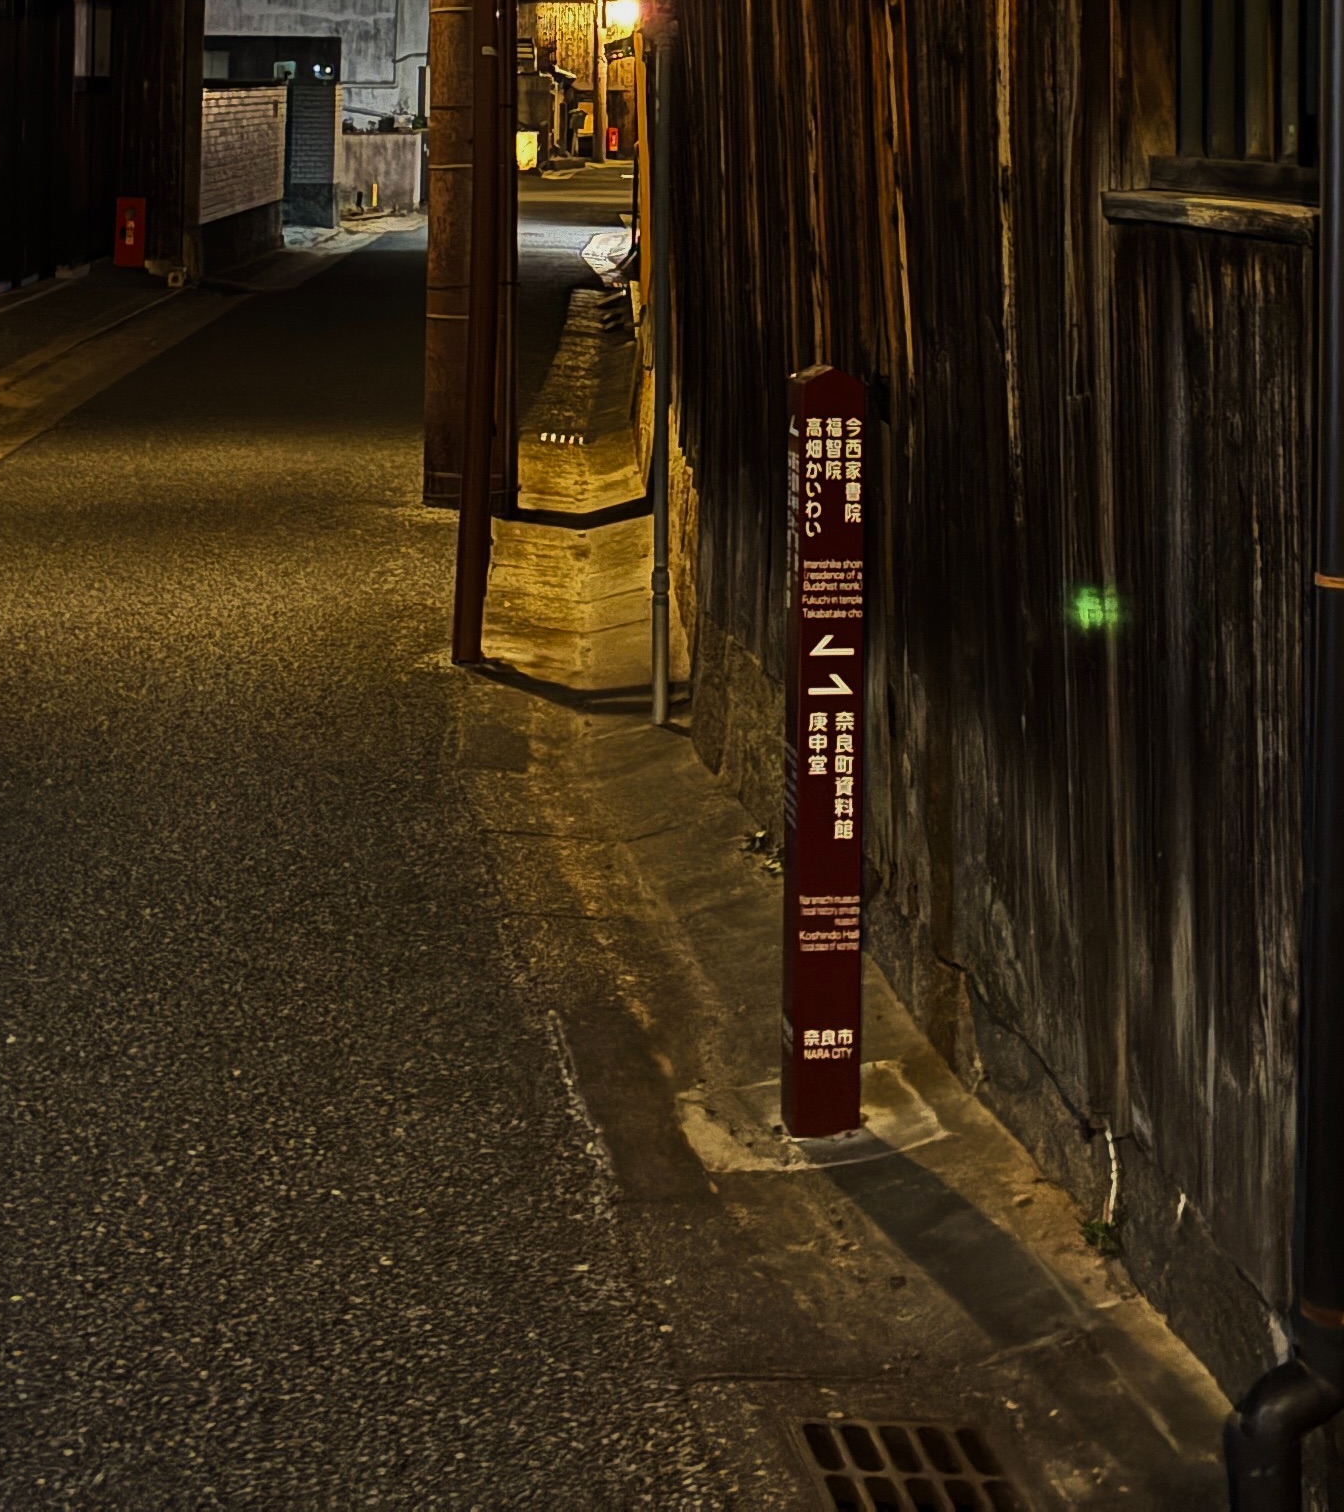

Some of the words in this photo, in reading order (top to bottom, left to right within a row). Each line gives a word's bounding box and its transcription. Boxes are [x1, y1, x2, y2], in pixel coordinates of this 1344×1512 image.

[805, 417, 823, 538] 高畑かいわい
[825, 417, 843, 481] 福智院
[844, 417, 863, 524] 今西家書院
[846, 569, 856, 580] of
[808, 711, 829, 775] 庚申堂
[833, 711, 855, 840] 奈良町資料館
[803, 1029, 854, 1046] 奈良市
[803, 1048, 830, 1059] NARA
[831, 1047, 853, 1059] CITY
